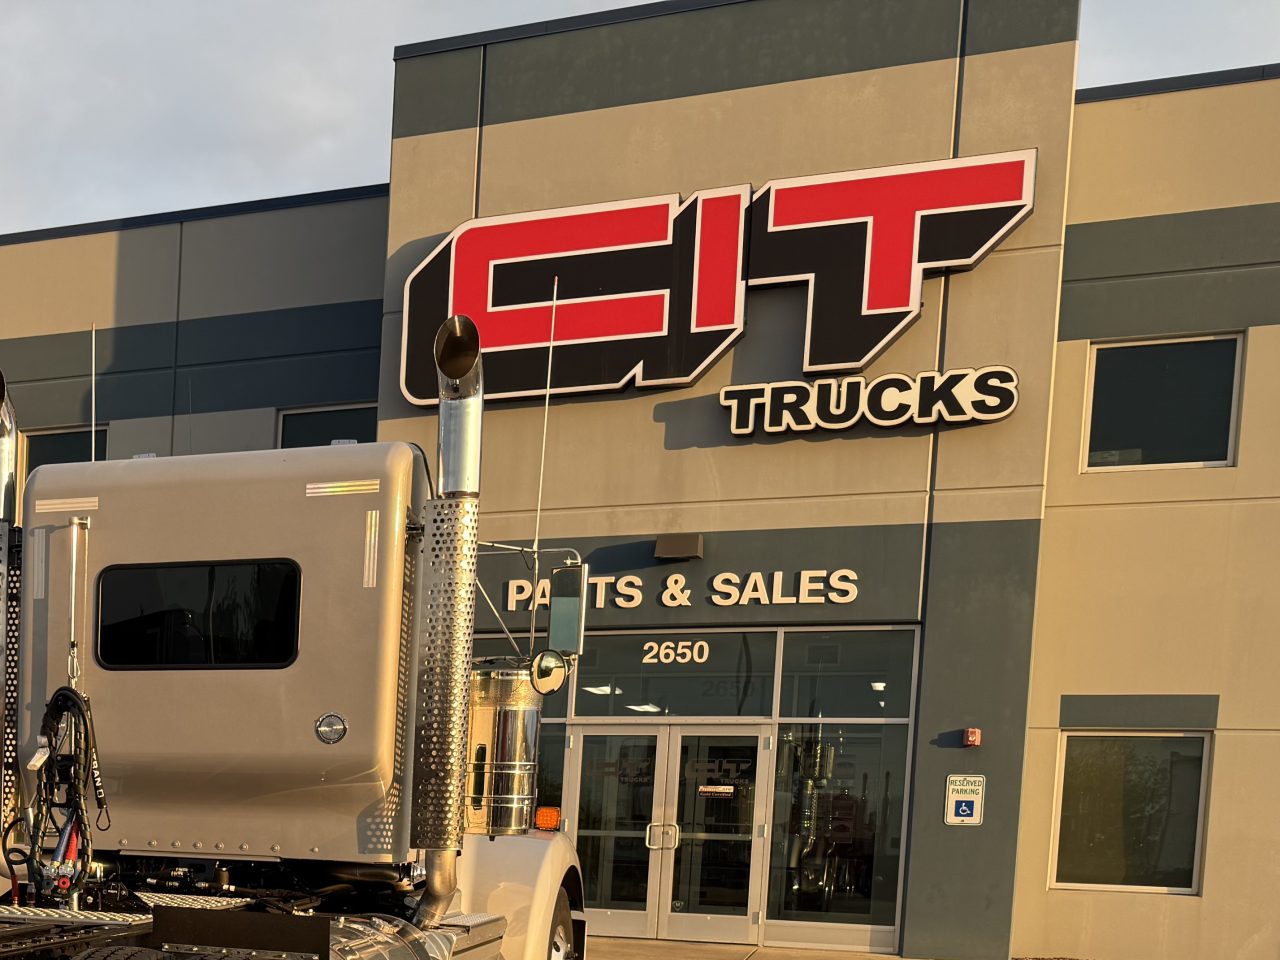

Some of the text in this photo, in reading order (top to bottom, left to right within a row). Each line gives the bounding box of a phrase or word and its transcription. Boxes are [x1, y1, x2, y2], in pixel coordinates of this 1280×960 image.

[445, 148, 1036, 372] CIT
[721, 366, 1018, 433] TRUCKS
[507, 569, 858, 611] PATS & SALES
[642, 640, 710, 664] 2650
[950, 779, 982, 787] RESERVED
